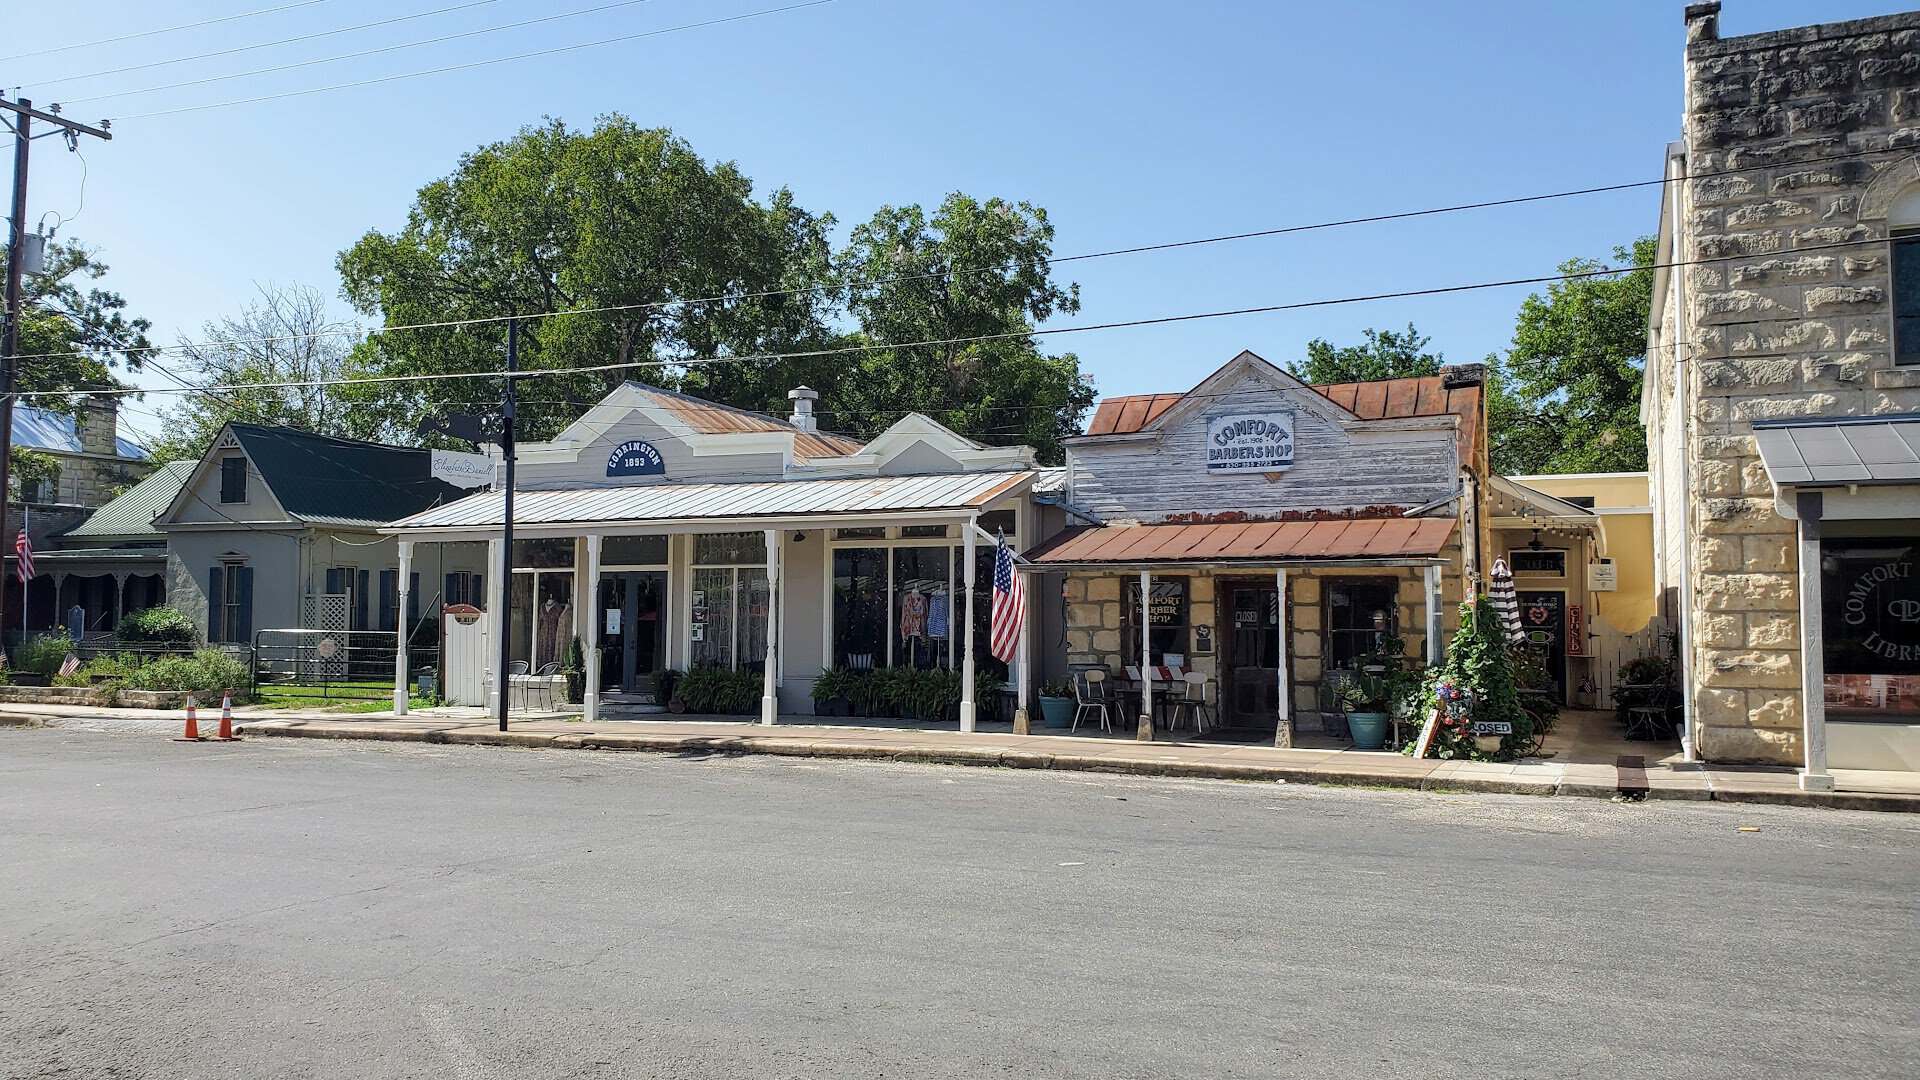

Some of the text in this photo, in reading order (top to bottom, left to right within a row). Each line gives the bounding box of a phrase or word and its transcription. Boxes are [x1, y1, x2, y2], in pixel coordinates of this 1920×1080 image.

[1214, 420, 1289, 446] COMFORT
[609, 443, 660, 468] CODRINGTON
[1209, 445, 1292, 460] BARBERSHOP
[1845, 562, 1912, 624] COMFORT
[1135, 606, 1177, 614] BRBER
[1235, 611, 1257, 622] CLOSED
[1473, 723, 1509, 731] LOSED
